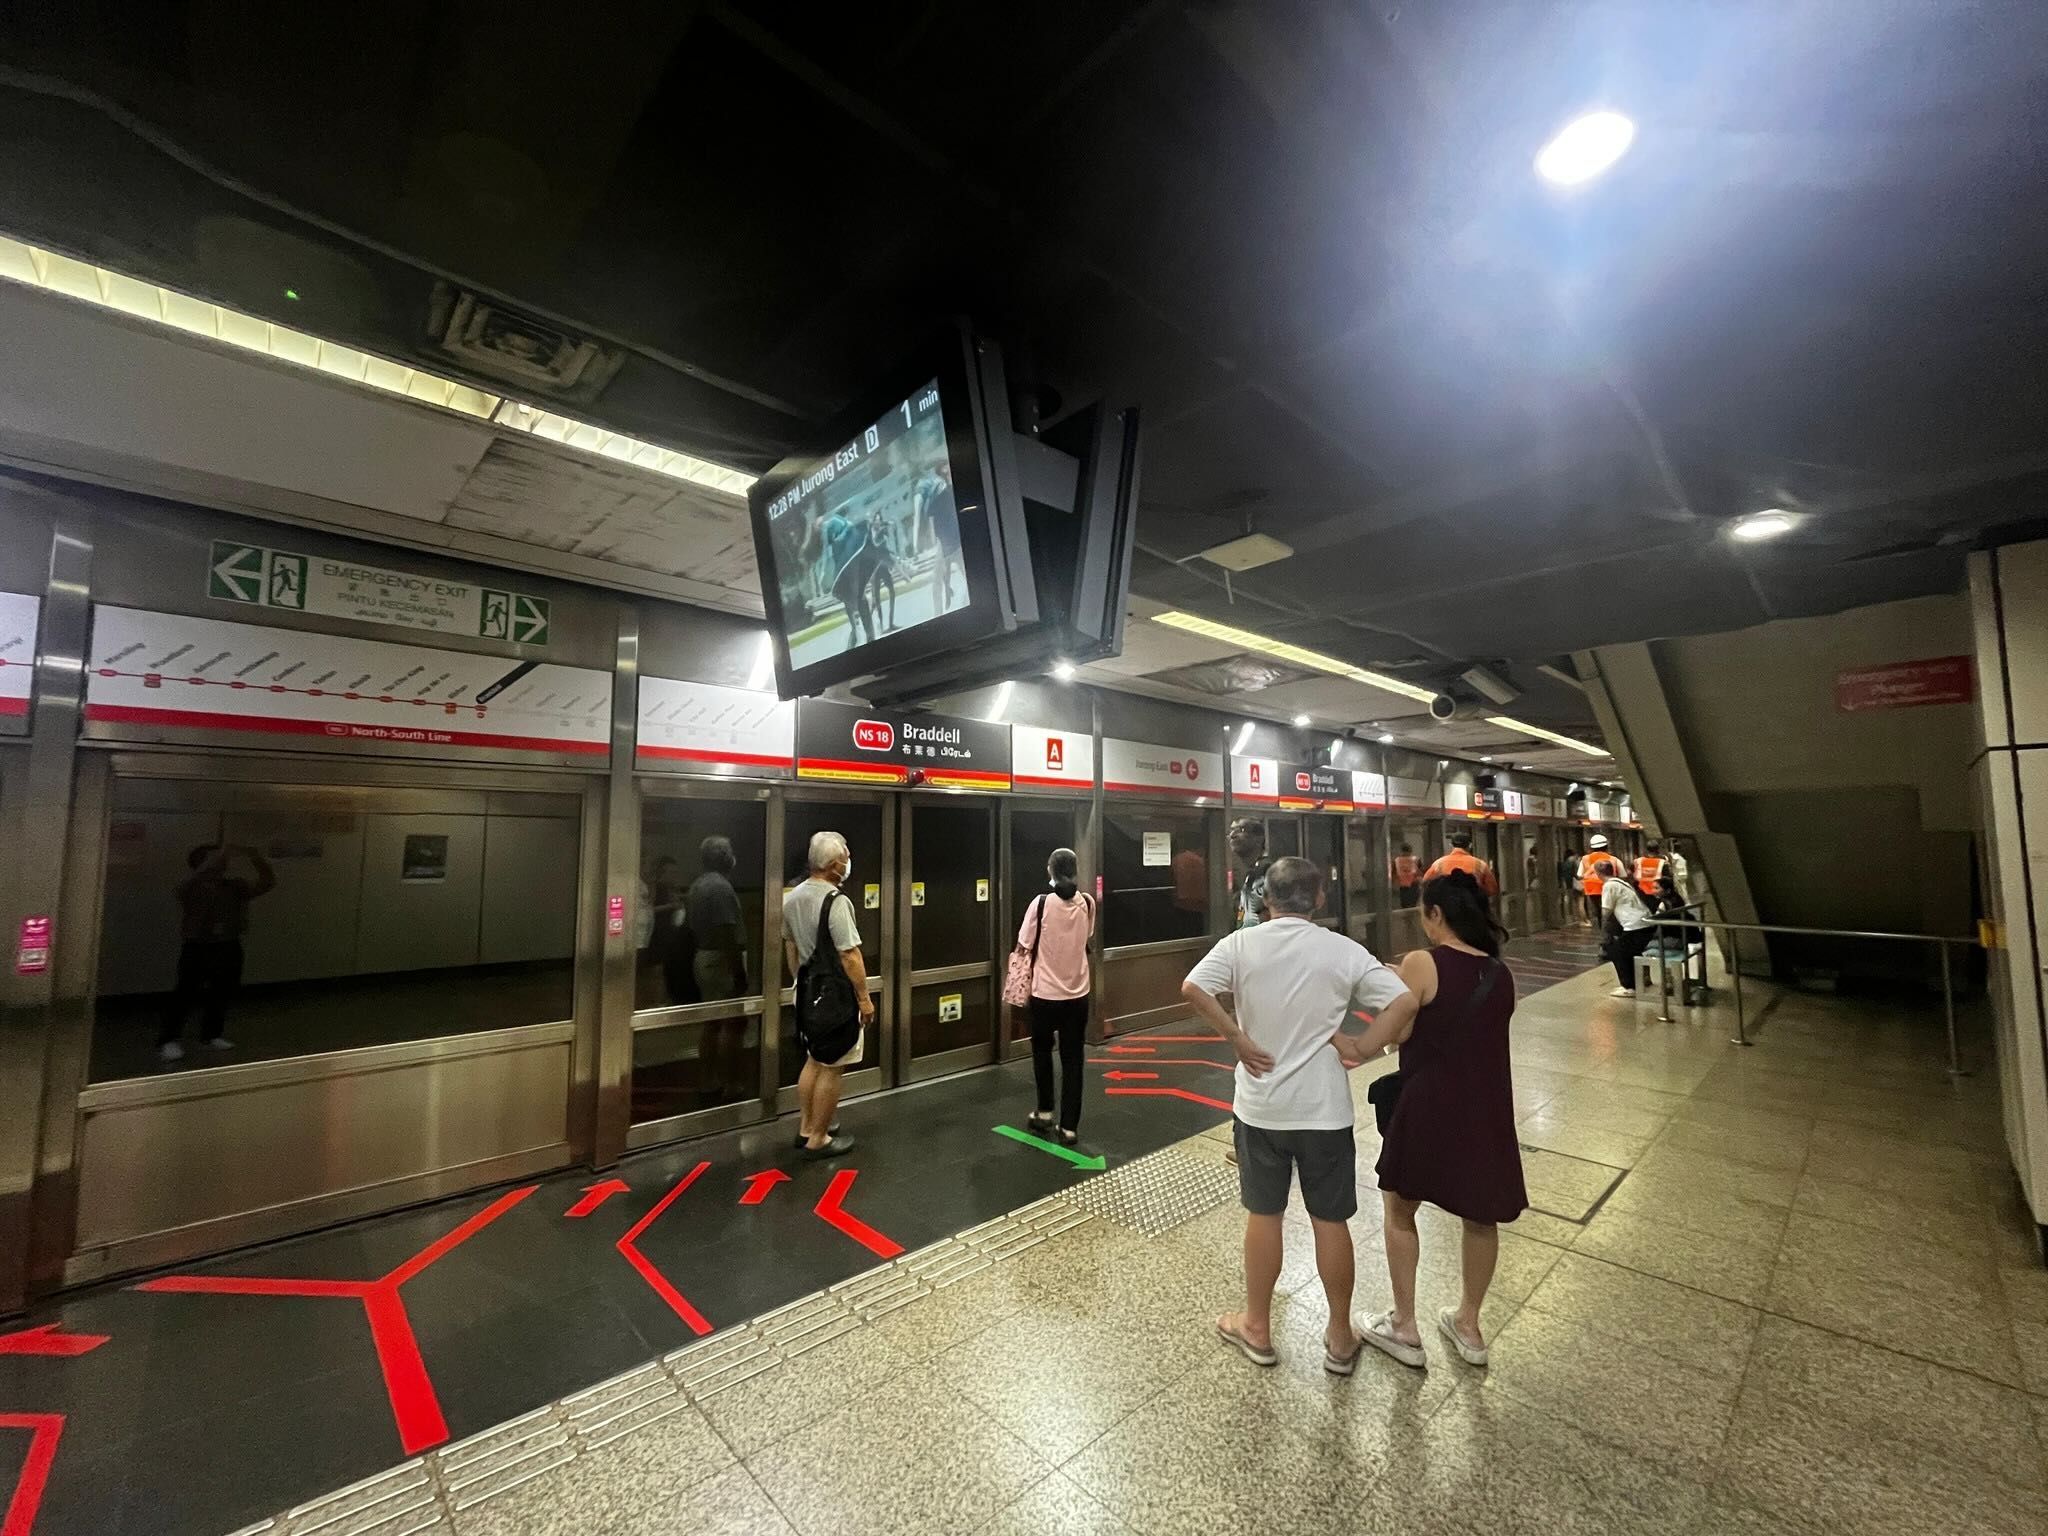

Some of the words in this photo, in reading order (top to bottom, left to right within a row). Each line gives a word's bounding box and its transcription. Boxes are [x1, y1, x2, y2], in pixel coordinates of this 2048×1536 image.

[787, 486, 801, 508] PM
[801, 463, 835, 497] Jurong
[835, 442, 859, 471] East
[900, 399, 913, 428] 1
[919, 390, 939, 412] min
[322, 563, 432, 592] EMERGENCY
[434, 583, 469, 599] EXIT
[351, 726, 426, 742] North-South
[428, 732, 452, 743] Line
[859, 729, 874, 742] NS
[876, 731, 890, 743] 18
[903, 723, 961, 744] Braddell
[1049, 744, 1060, 761] A
